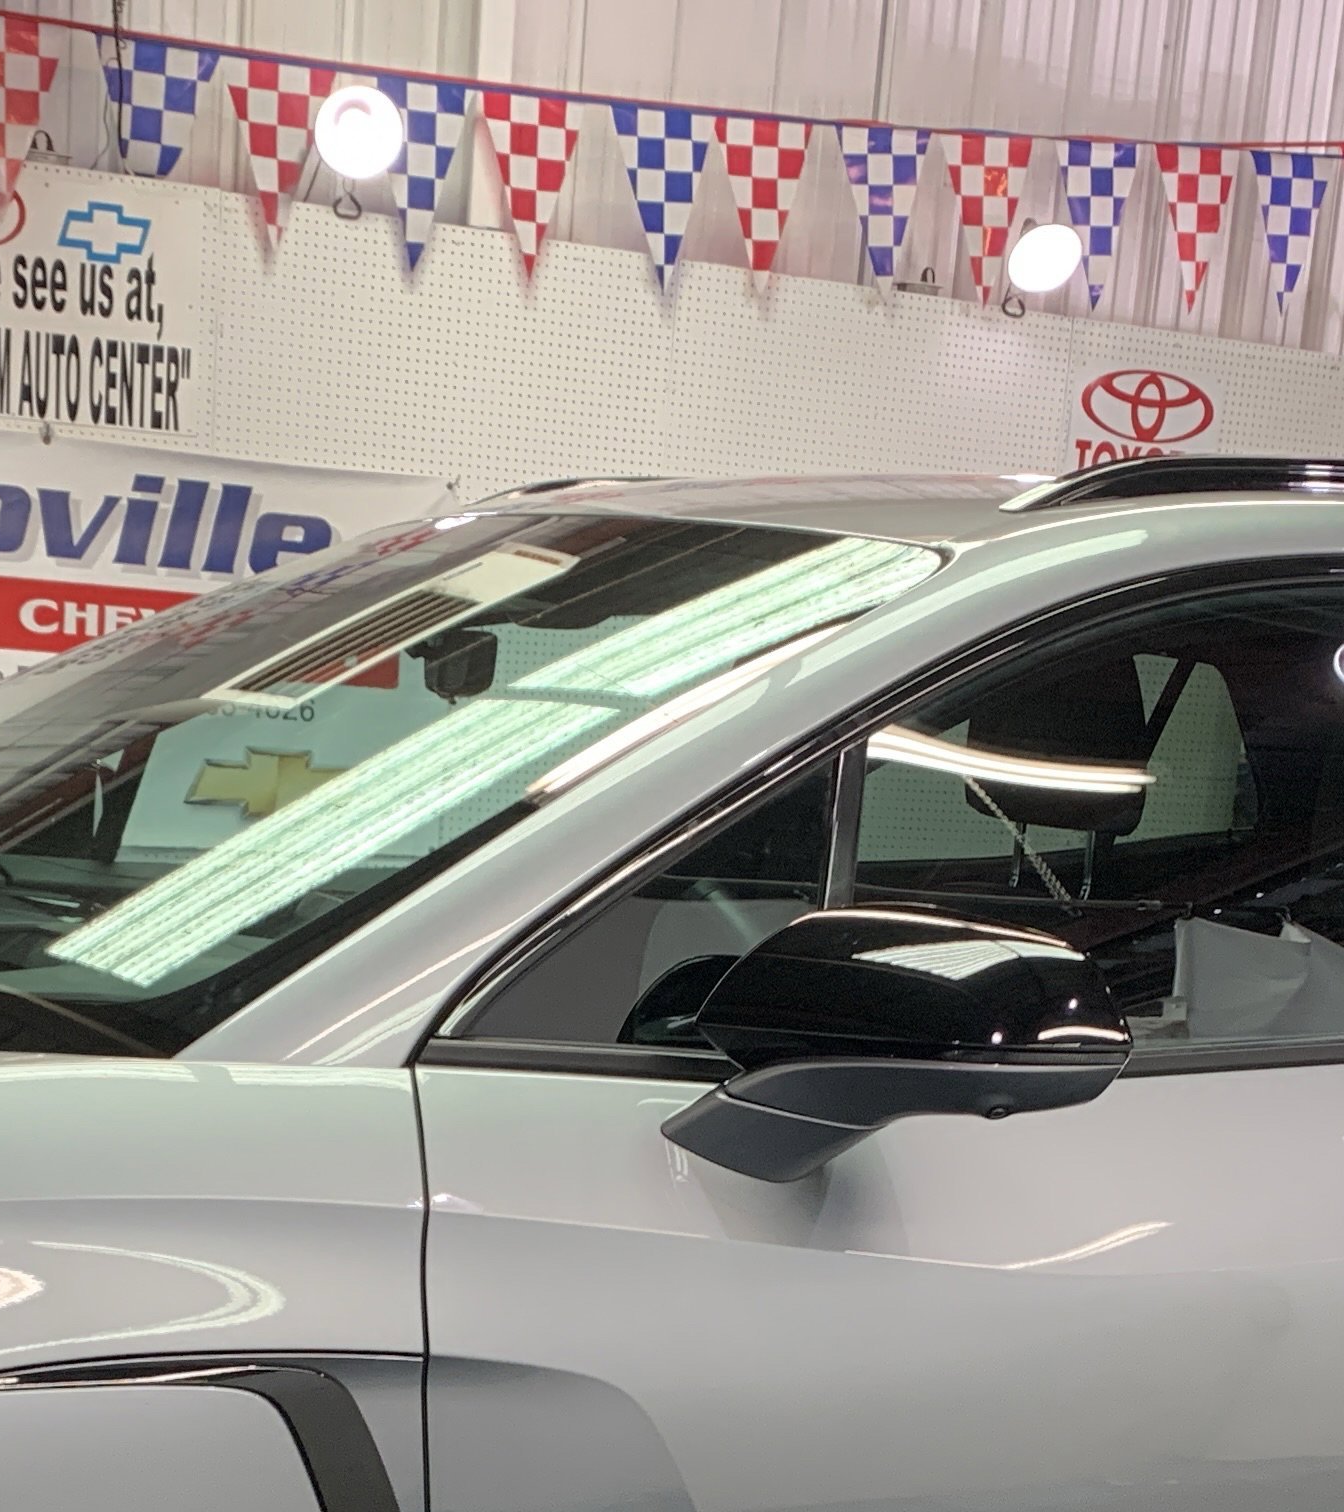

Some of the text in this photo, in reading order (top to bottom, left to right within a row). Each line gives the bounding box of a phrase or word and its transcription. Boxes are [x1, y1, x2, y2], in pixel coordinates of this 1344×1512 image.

[13, 252, 67, 313] see
[80, 260, 114, 318] us
[126, 254, 164, 340] at,
[18, 331, 81, 422] AUTO
[89, 337, 192, 432] CENTER"
